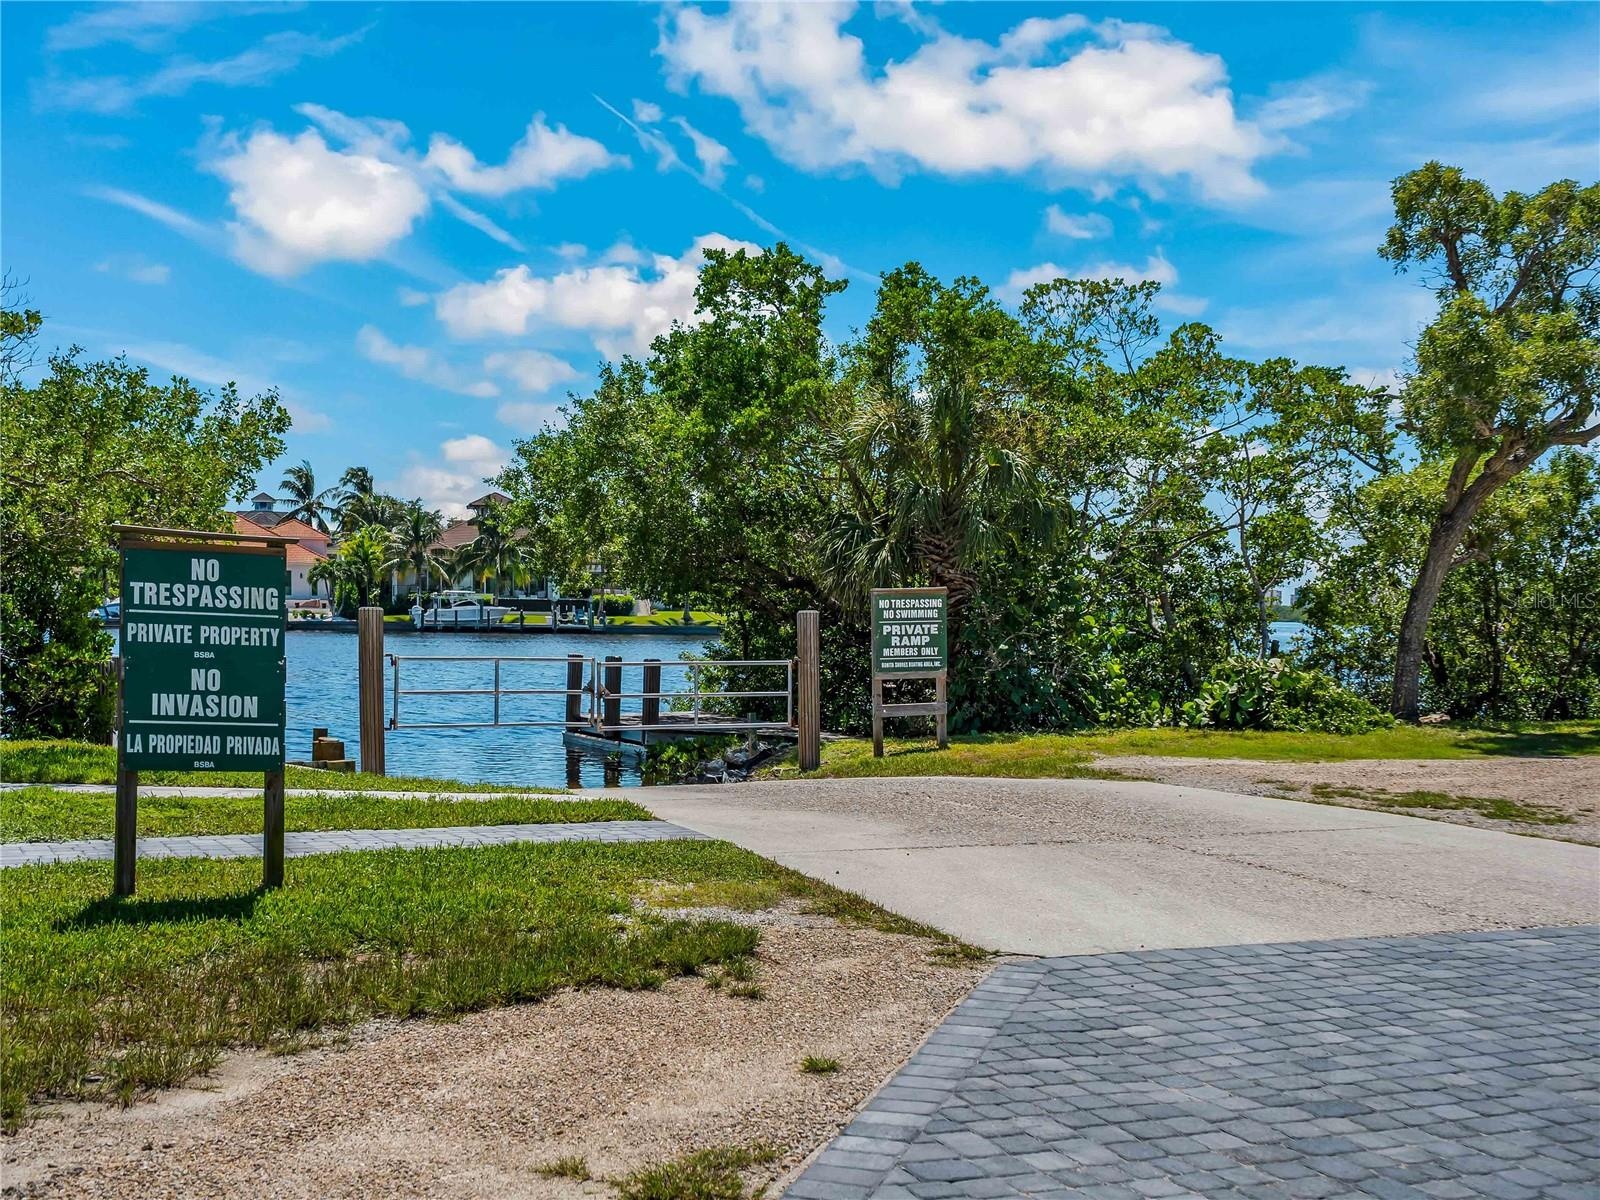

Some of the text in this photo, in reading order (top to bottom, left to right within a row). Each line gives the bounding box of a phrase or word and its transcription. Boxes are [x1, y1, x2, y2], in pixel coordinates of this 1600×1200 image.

[191, 558, 220, 582] NO
[130, 582, 279, 611] TRESPASSING
[879, 599, 942, 608] NO TRESPASSING
[884, 609, 938, 618] NO SWIMMING
[127, 623, 280, 647] PRIVATE PROPERTY
[883, 624, 938, 635] PRIVATE
[883, 647, 938, 656] MEMBERS ONLY
[892, 636, 930, 646] RAMP
[191, 668, 220, 692] NO
[152, 693, 258, 718] INVASION
[126, 734, 280, 756] LA PROPIEDAD PRIVADA
